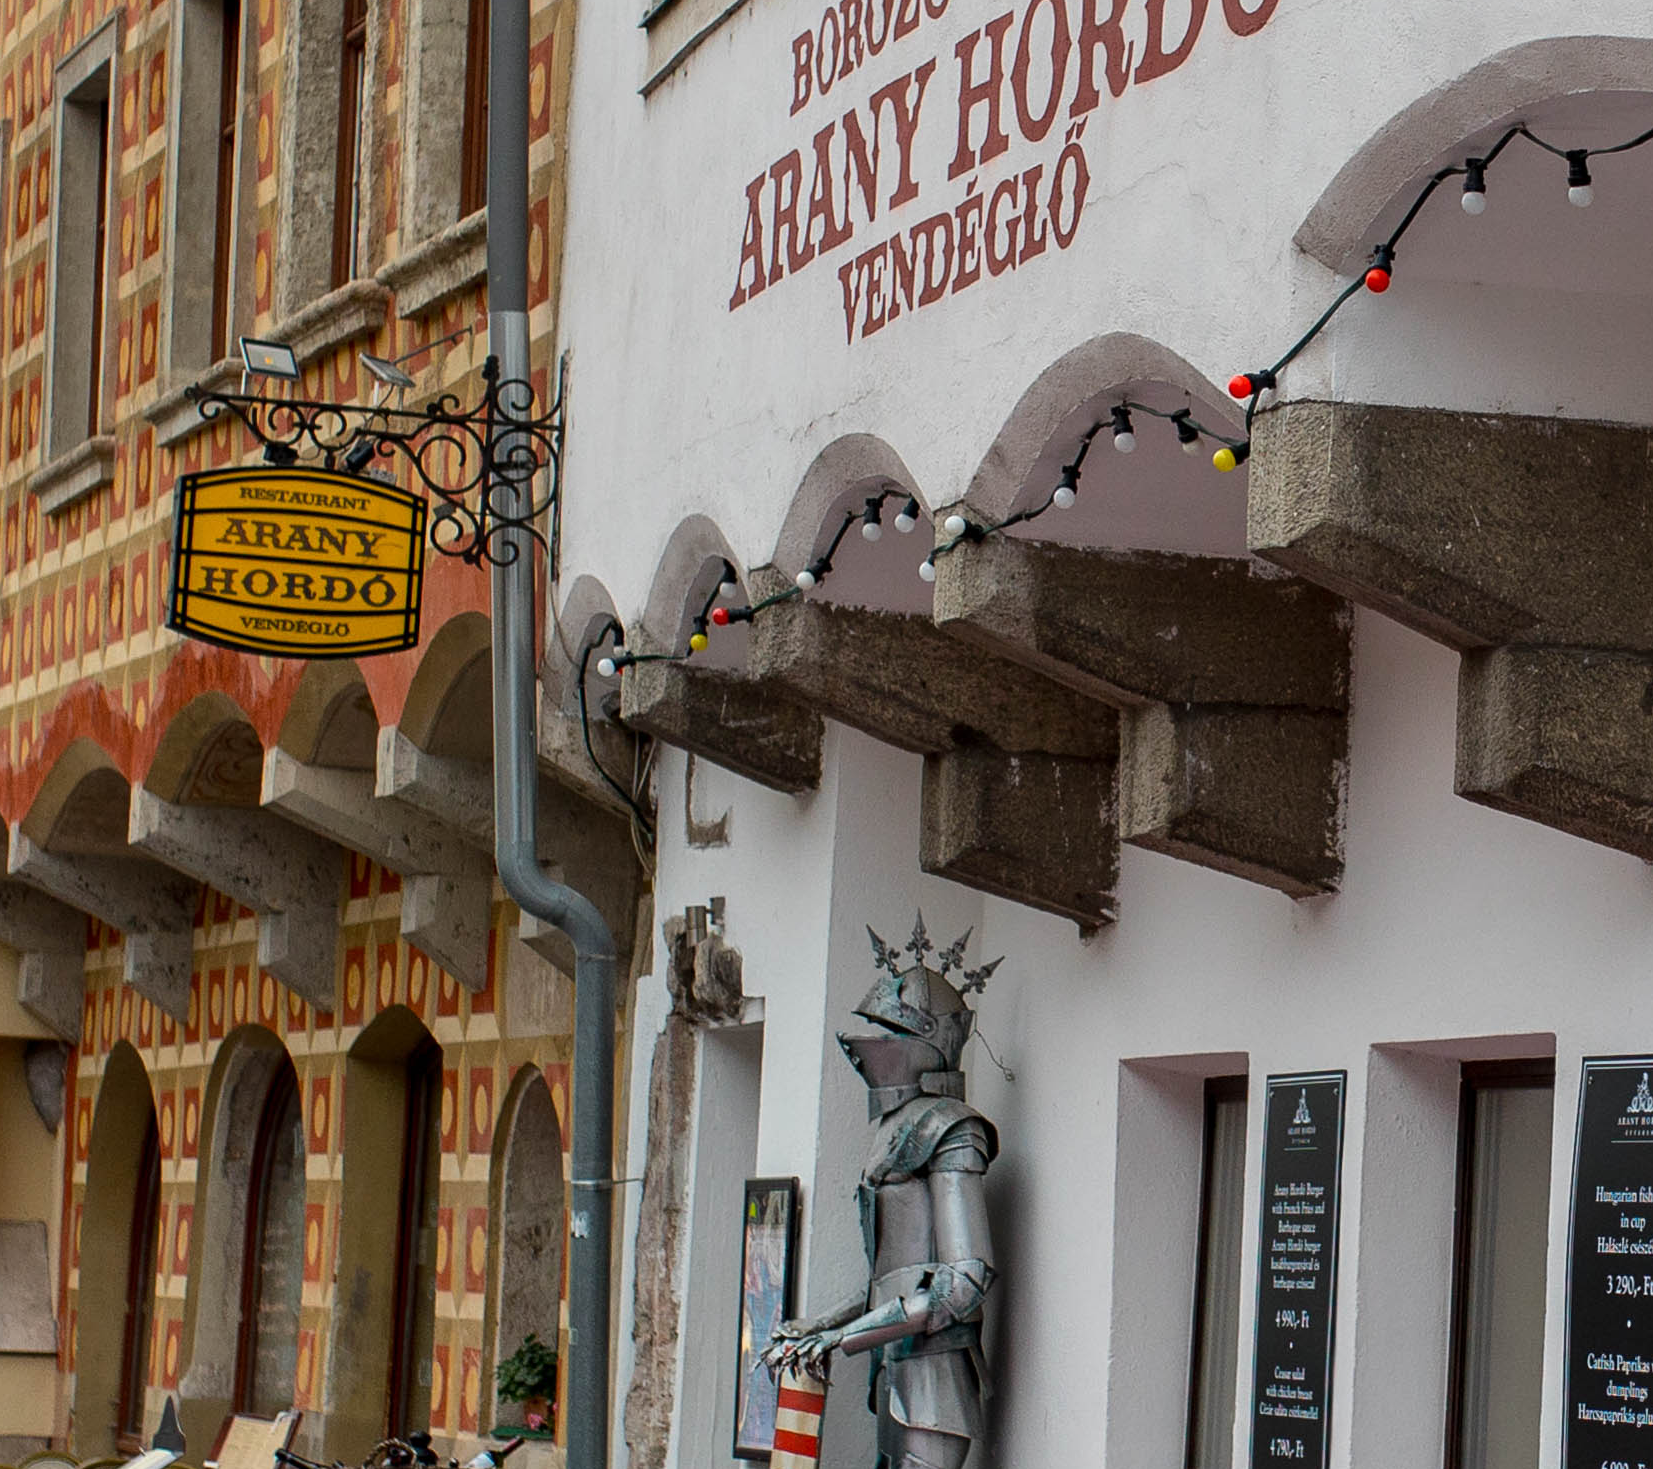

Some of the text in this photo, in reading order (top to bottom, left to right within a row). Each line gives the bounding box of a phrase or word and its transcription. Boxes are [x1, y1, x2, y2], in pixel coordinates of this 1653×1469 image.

[729, 57, 936, 312] ARANY
[838, 116, 1091, 346] VENDÉGLŐ
[240, 487, 370, 511] RESTAURANT
[216, 518, 386, 560] ARANY
[198, 566, 397, 607] HORDÓ
[1596, 1186, 1637, 1207] Hungarian
[1639, 1186, 1653, 1203] fish
[1620, 1212, 1646, 1232] in cup
[1606, 1275, 1613, 1294] 3
[1615, 1275, 1641, 1298] 290,-
[1587, 1352, 1614, 1371] Catfish
[1606, 1380, 1648, 1402] dumplings
